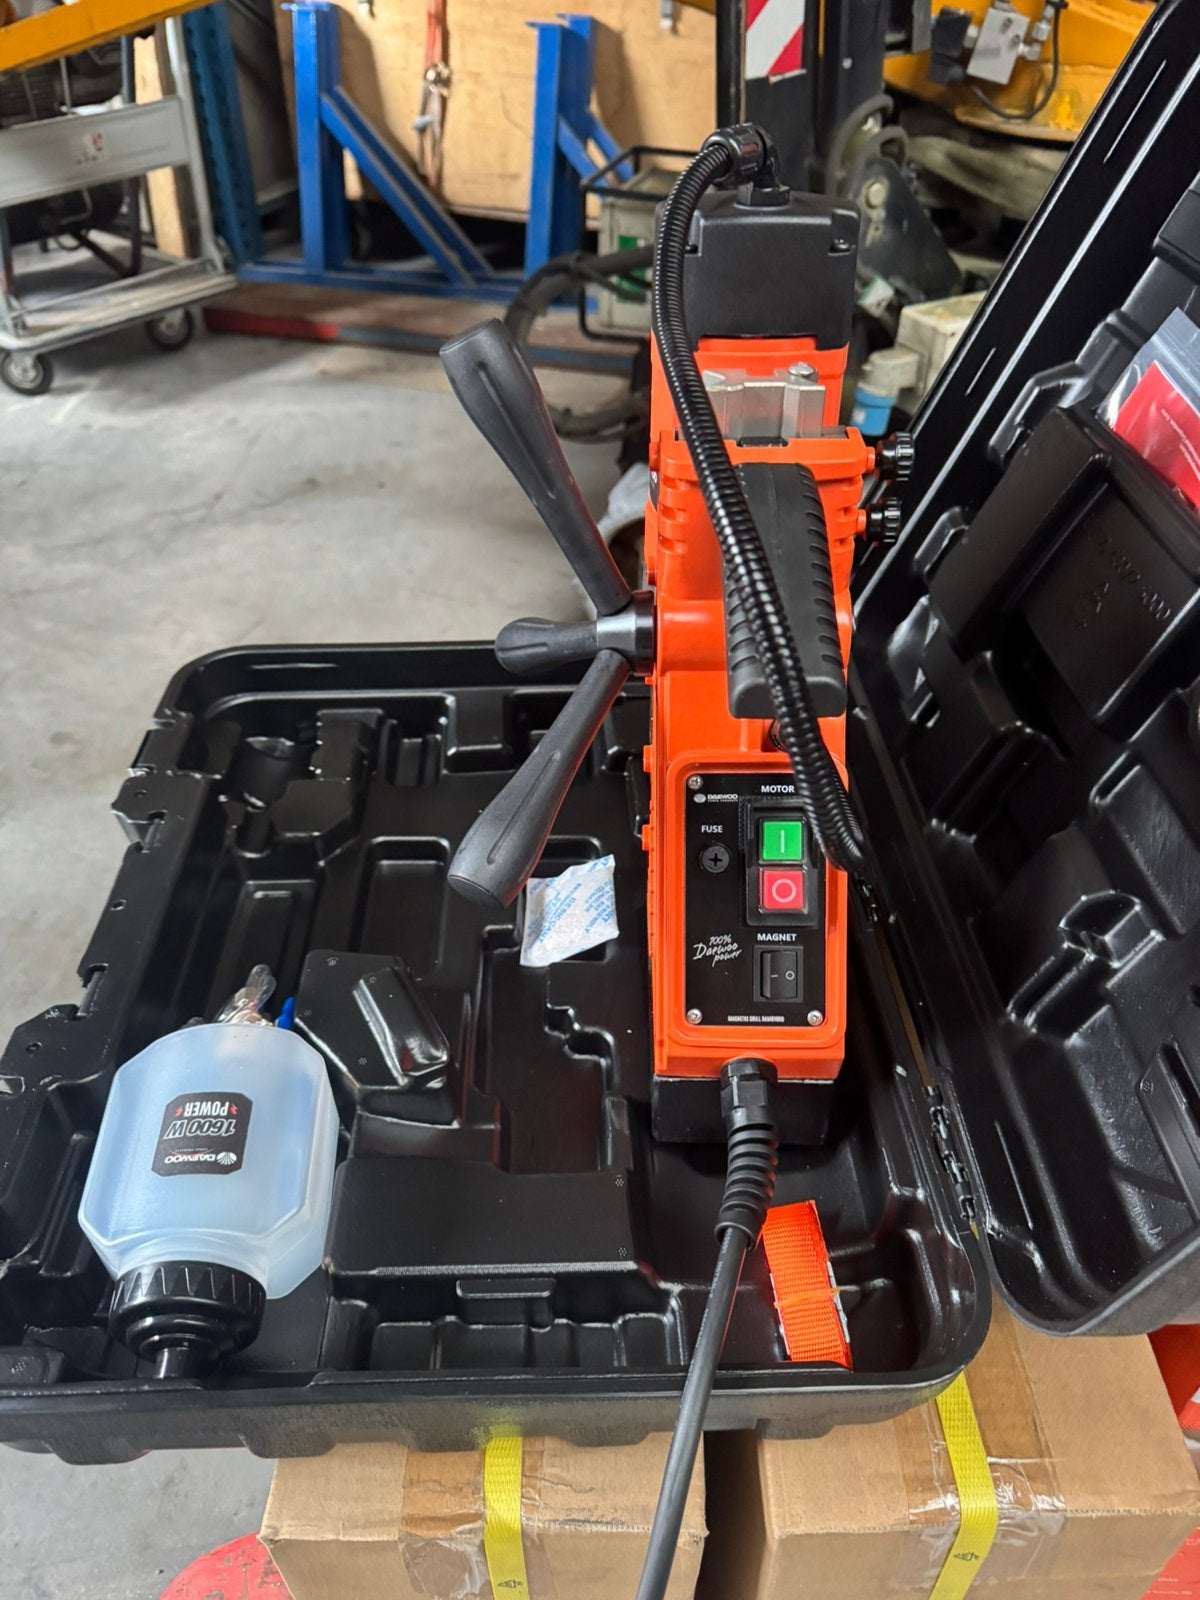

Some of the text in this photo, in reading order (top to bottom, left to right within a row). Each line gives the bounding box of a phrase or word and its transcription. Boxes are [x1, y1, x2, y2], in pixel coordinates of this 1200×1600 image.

[761, 785, 795, 793] MOTOR
[701, 825, 723, 833] FUSE
[709, 934, 732, 946] 100%
[757, 933, 797, 941] MAGNET
[693, 943, 738, 960] Daewoo
[712, 949, 742, 967] power
[184, 1101, 229, 1117] POWER
[164, 1153, 216, 1164] DAEWOO
